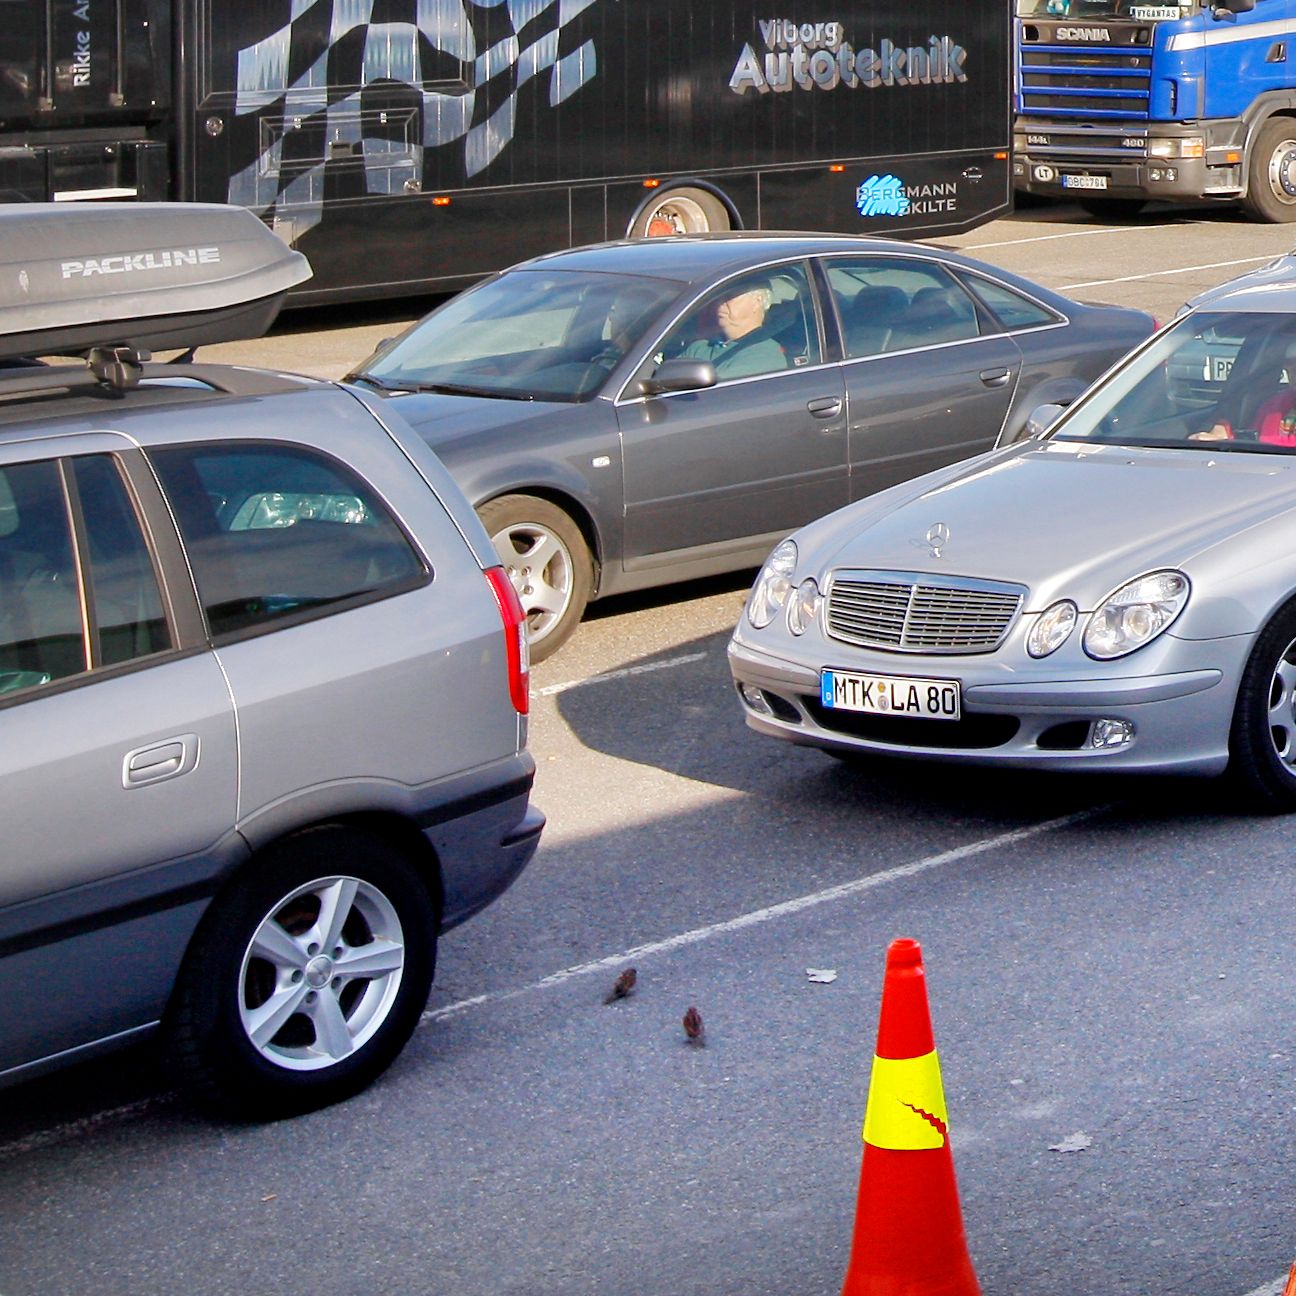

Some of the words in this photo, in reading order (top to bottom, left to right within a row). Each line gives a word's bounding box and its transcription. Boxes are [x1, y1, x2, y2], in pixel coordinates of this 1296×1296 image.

[759, 19, 844, 51] Viborg
[1056, 27, 1111, 42] SCANIA
[73, 30, 91, 87] Rikke
[729, 34, 968, 95] Autoteknik
[1038, 169, 1049, 180] LT
[61, 247, 221, 279] PACKLINE
[834, 676, 875, 708] MTK
[891, 683, 920, 712] LA
[927, 686, 956, 715] 80
